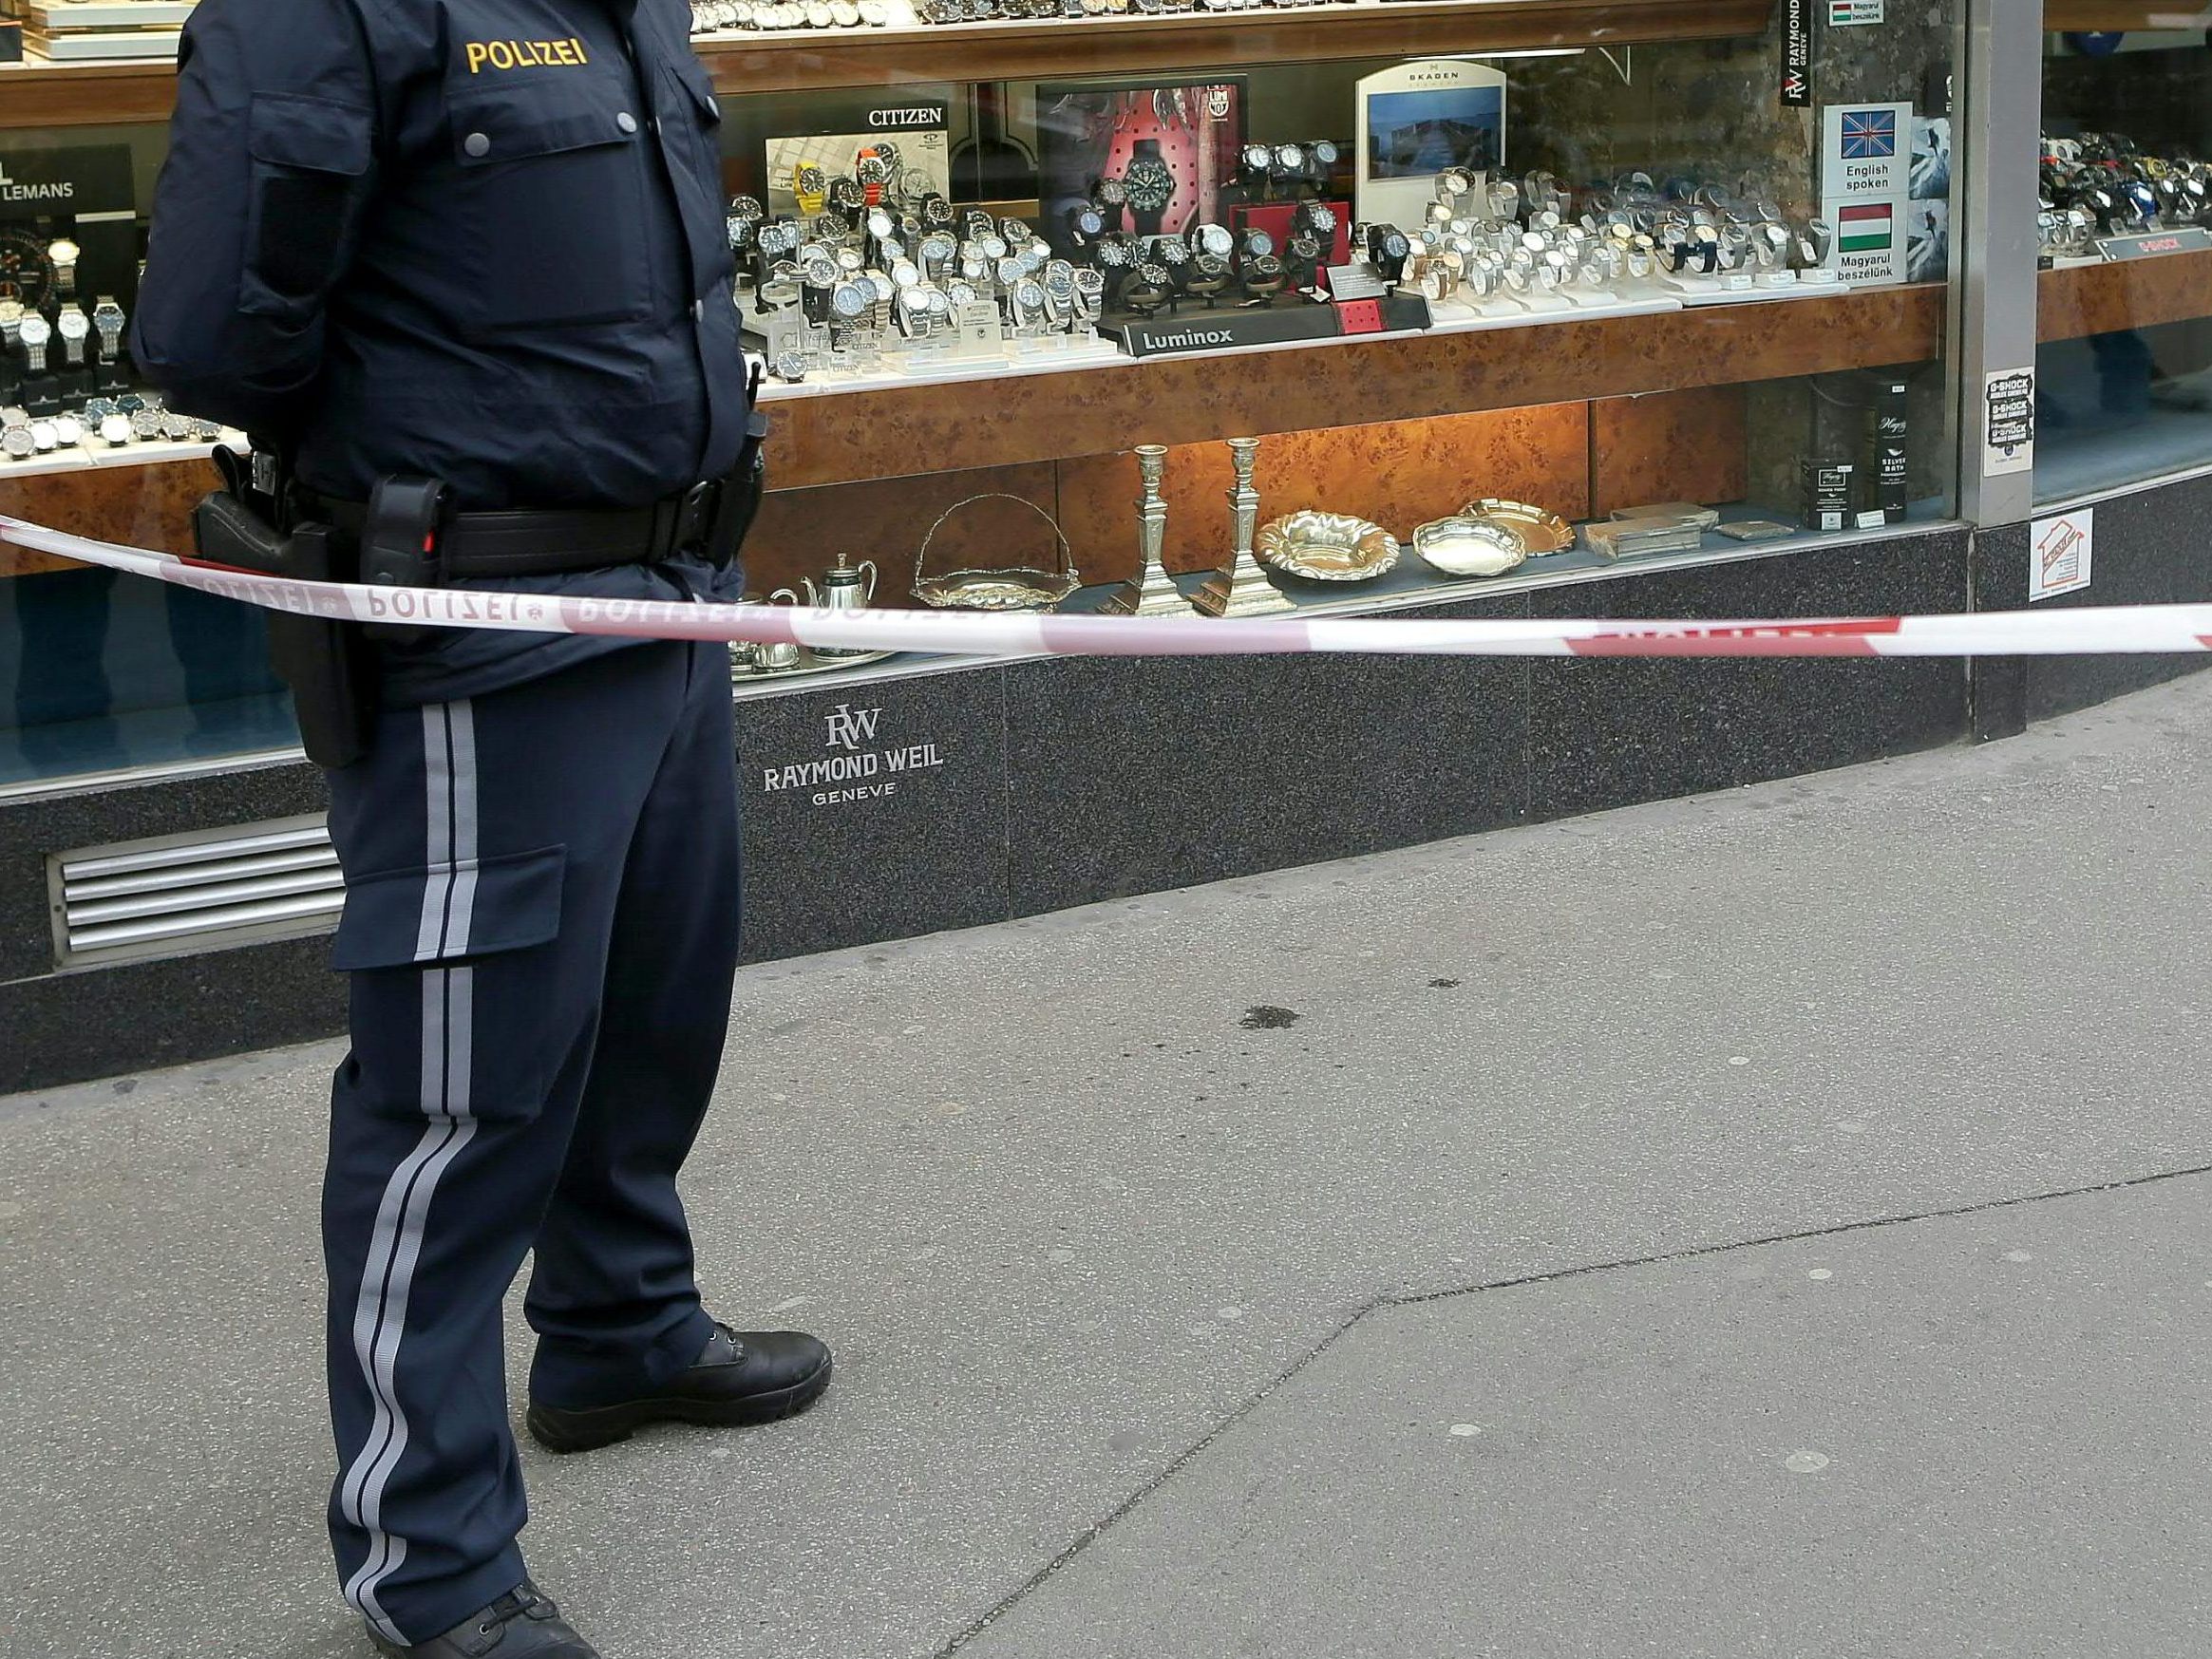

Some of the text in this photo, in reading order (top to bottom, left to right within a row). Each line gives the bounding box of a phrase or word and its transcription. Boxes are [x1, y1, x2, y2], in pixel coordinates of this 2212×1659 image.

[1789, 0, 1800, 66] RAYMOND
[466, 38, 587, 73] POLIZEI
[868, 107, 942, 126] CITIZEN
[1846, 164, 1889, 178] English
[3, 182, 74, 200] LEMANS
[1846, 179, 1889, 191] spoken
[1841, 254, 1891, 267] Magyarul
[1838, 268, 1893, 280] beszélünk
[1143, 329, 1234, 349] Luminox
[1990, 379, 2029, 392] G-SHOCK
[1992, 400, 2028, 414] G-SHOCK
[764, 744, 944, 792] RAYMOND WEIL
[812, 782, 897, 805] GENEVE
